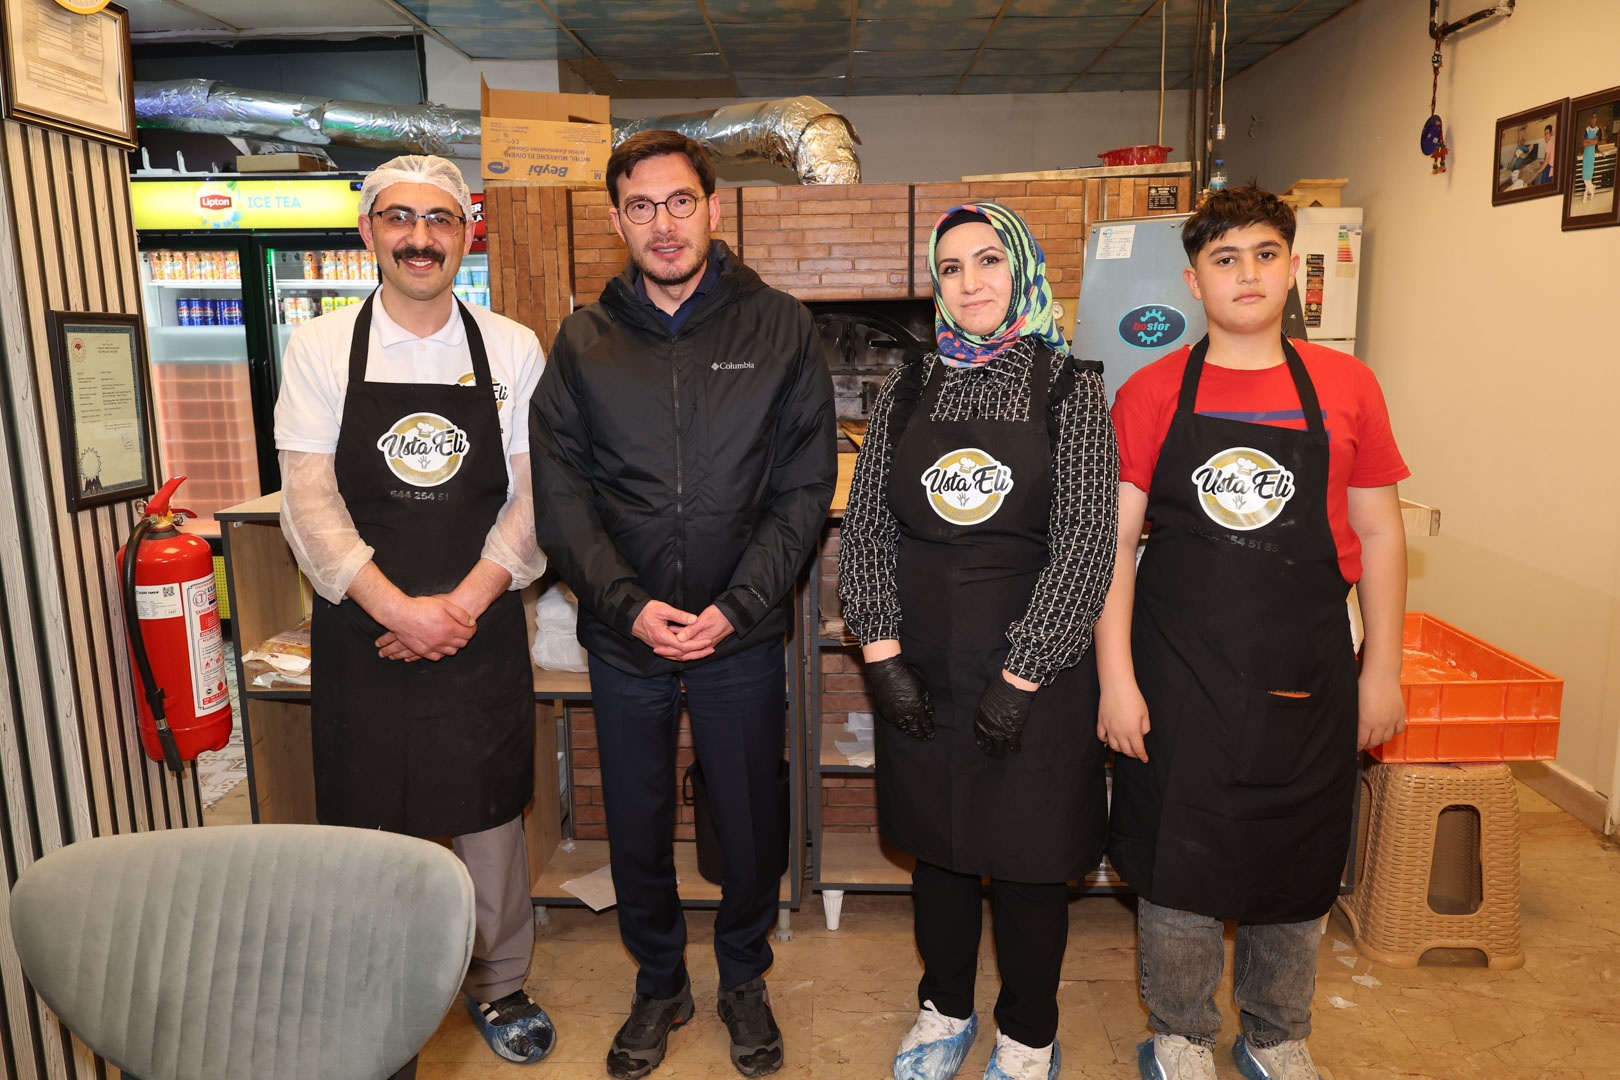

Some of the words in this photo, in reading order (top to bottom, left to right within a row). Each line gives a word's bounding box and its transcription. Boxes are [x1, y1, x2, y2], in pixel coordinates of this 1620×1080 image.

[528, 164, 568, 178] Beybi
[594, 172, 602, 180] M
[202, 198, 230, 208] Lipton
[248, 196, 271, 208] ICE
[275, 196, 302, 208] TEA
[1132, 322, 1170, 331] bosfor
[720, 361, 754, 370] Columbia
[382, 434, 433, 458] Usta
[432, 430, 466, 457] Eli
[925, 468, 972, 494] Usta
[972, 465, 1010, 494] Eli
[1196, 467, 1251, 496] Usta
[1252, 470, 1292, 499] Eli
[414, 491, 435, 500] 254
[1248, 540, 1262, 550] 51
